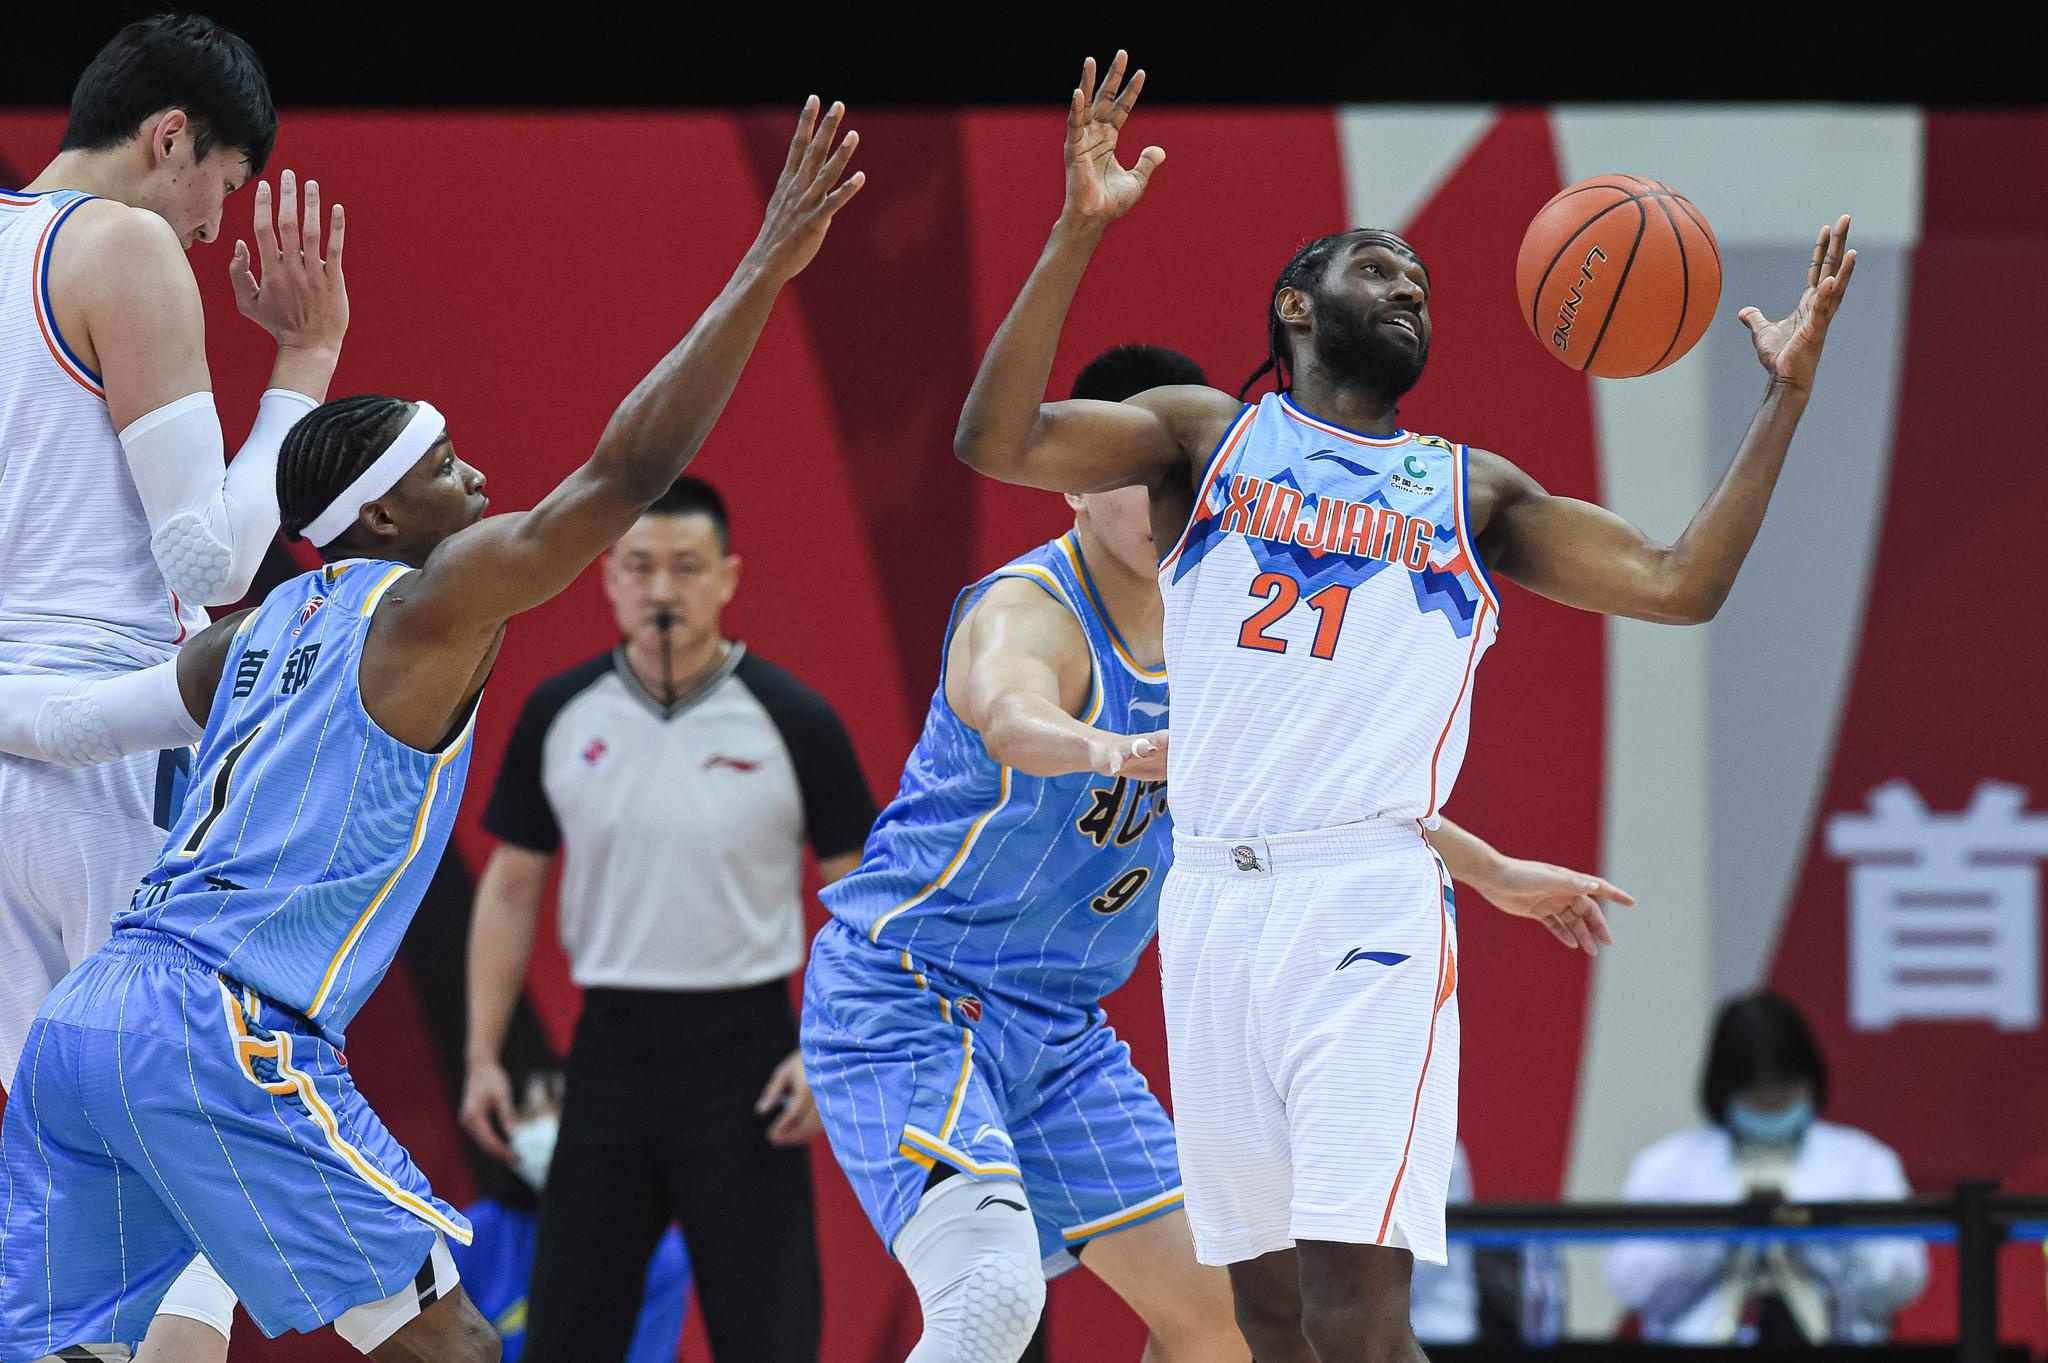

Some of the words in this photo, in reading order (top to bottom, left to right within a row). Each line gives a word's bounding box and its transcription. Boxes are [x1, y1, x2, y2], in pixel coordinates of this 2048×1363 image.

[1552, 245, 1608, 352] LI-NING
[1218, 473, 1435, 573] XINJIANG
[1390, 482, 1414, 494] CHINA
[1236, 571, 1353, 662] 21
[176, 720, 269, 859] 1
[1090, 866, 1151, 915] 9
[1824, 776, 2048, 1033] 首
